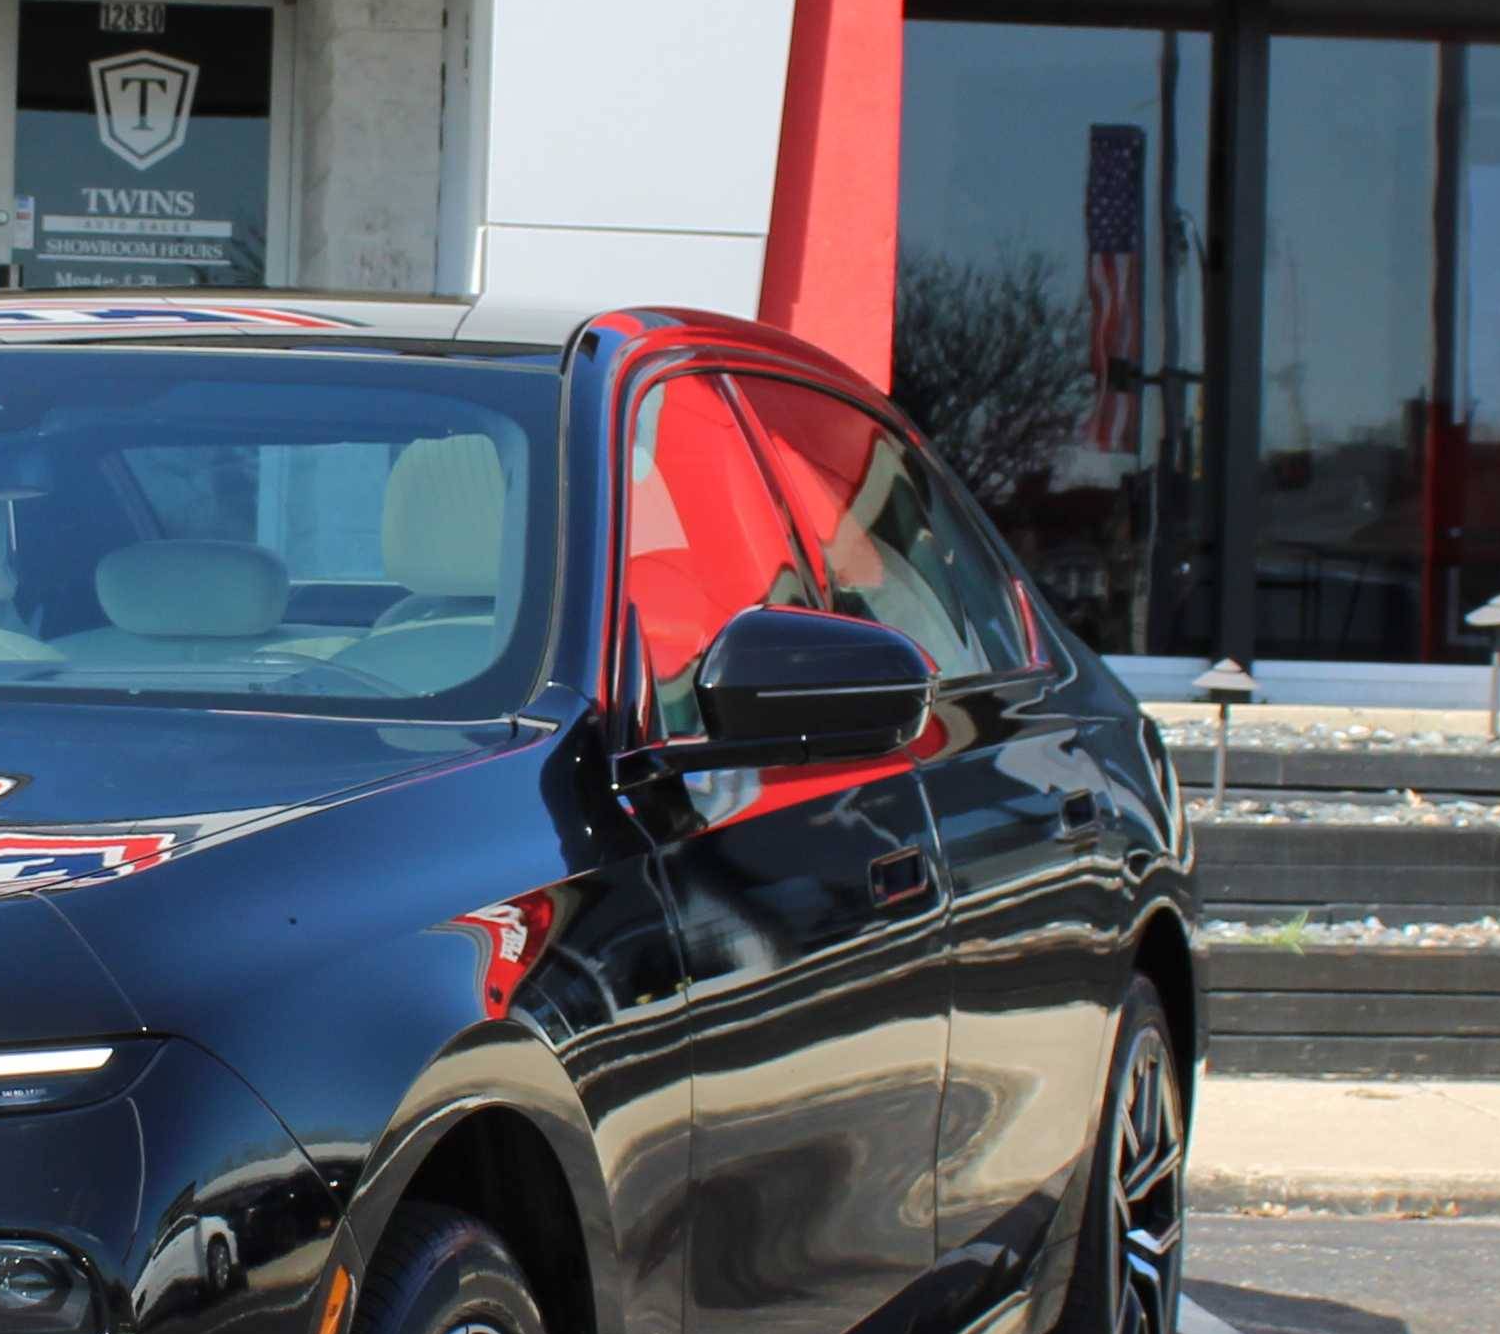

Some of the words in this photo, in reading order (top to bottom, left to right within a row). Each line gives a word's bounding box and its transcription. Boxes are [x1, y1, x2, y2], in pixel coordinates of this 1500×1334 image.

[103, 2, 166, 33] 12830
[120, 77, 169, 131] T
[81, 187, 195, 217] TWINS
[45, 238, 157, 257] SHOWROOM
[160, 242, 224, 260] HOURS
